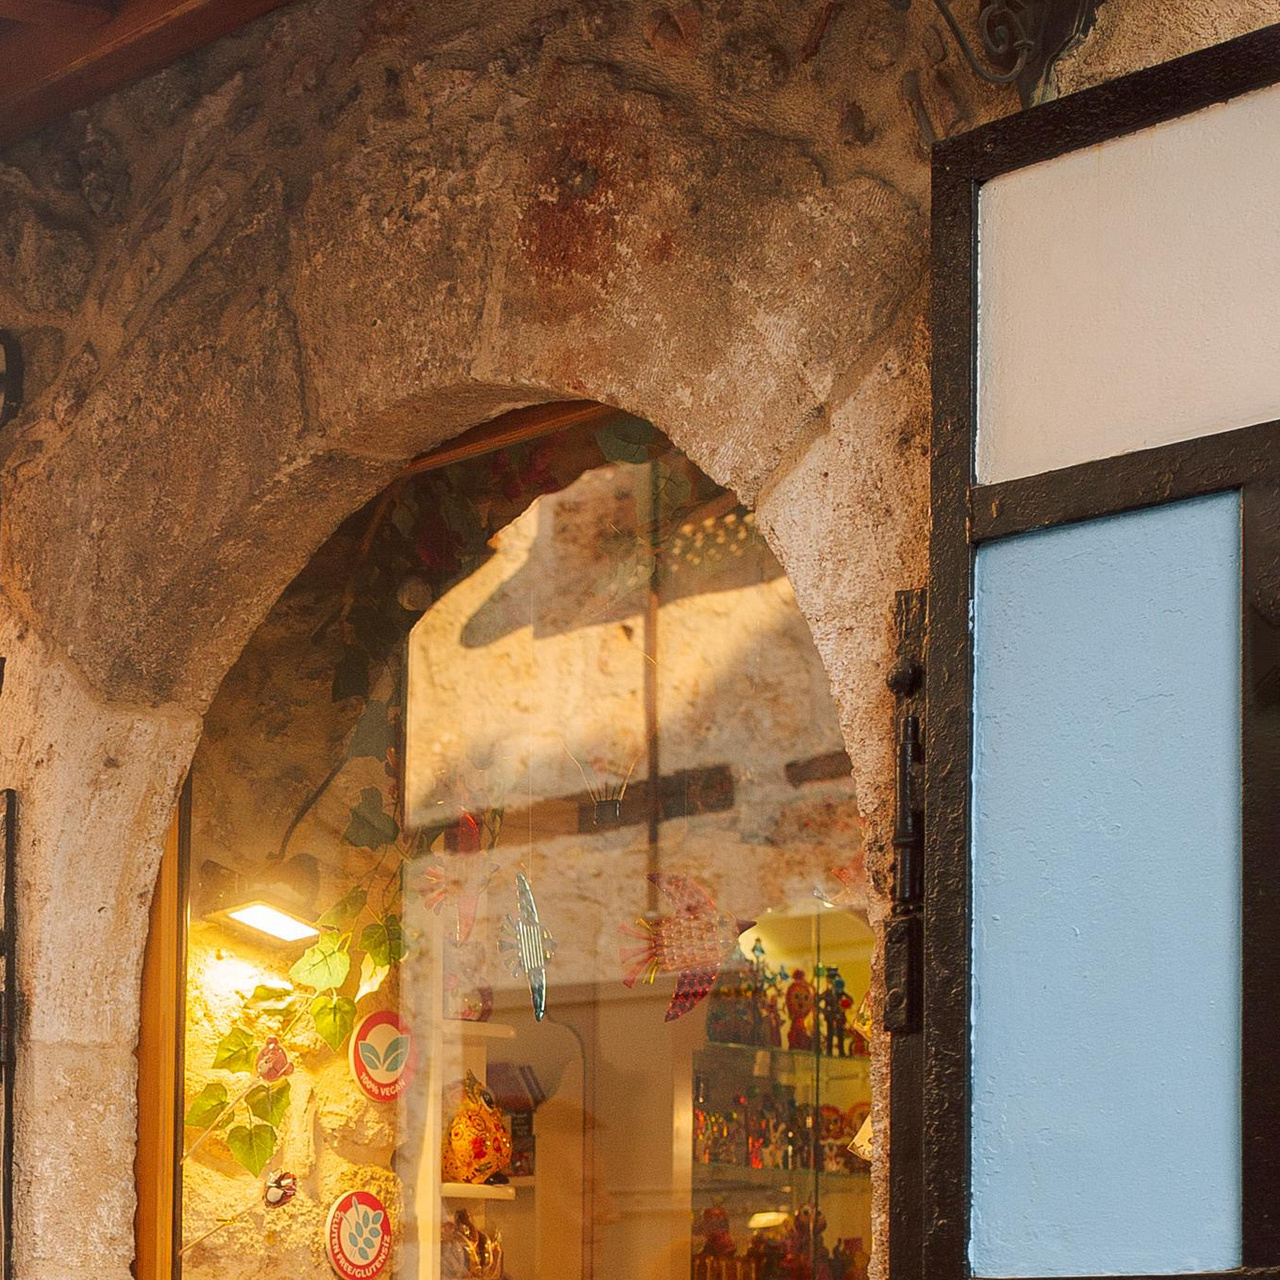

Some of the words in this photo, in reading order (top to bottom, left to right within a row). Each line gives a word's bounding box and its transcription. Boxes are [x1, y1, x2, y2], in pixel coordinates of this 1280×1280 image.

[360, 1072, 379, 1095] 100%
[380, 1079, 406, 1096] VEGAN
[331, 1211, 341, 1254] GLUTEN
